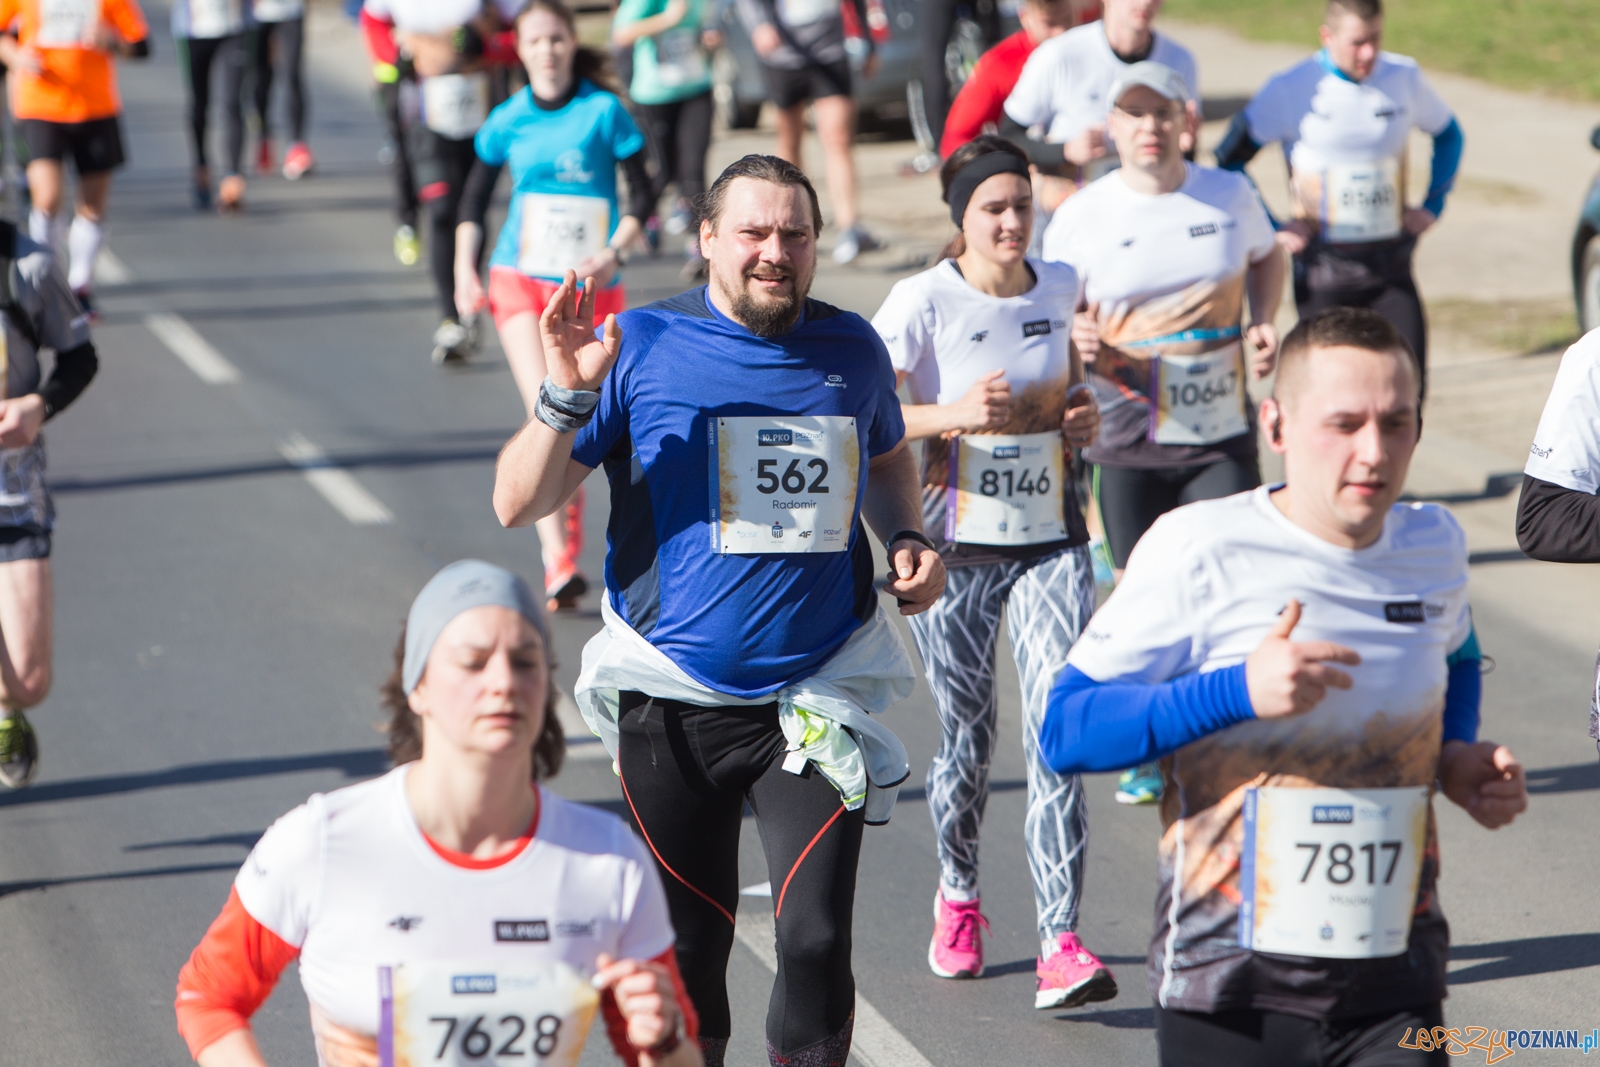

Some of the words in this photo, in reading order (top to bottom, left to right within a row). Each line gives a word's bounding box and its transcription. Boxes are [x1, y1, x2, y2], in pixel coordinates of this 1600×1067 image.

[1167, 370, 1238, 407] 10647
[756, 458, 829, 494] 562
[979, 466, 1050, 497] 8146
[772, 500, 817, 510] Radomir
[798, 530, 812, 538] 4F
[1295, 841, 1402, 885] 7817
[429, 1012, 562, 1059] 7628
